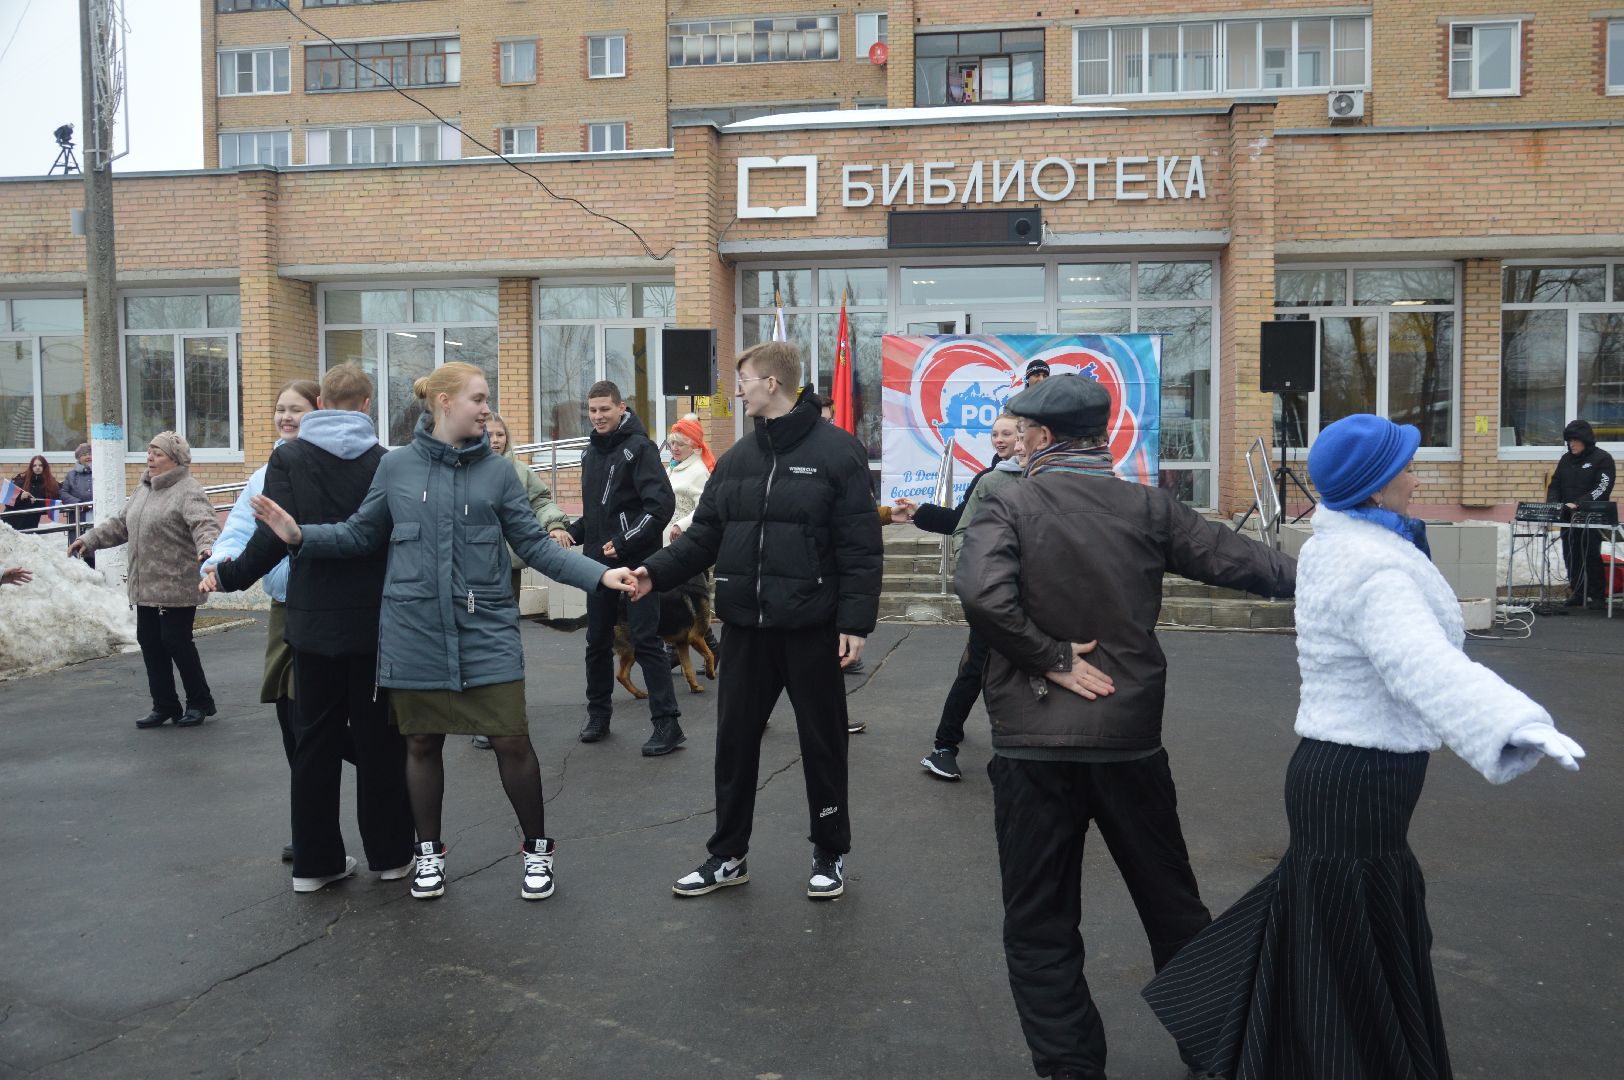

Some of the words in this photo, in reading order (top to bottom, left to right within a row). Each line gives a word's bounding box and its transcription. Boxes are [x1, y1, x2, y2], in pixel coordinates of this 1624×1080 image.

[842, 155, 1206, 207] БИБЛИОТЕКА
[961, 404, 1004, 426] РО
[903, 470, 913, 482] В
[915, 469, 944, 481] Ден
